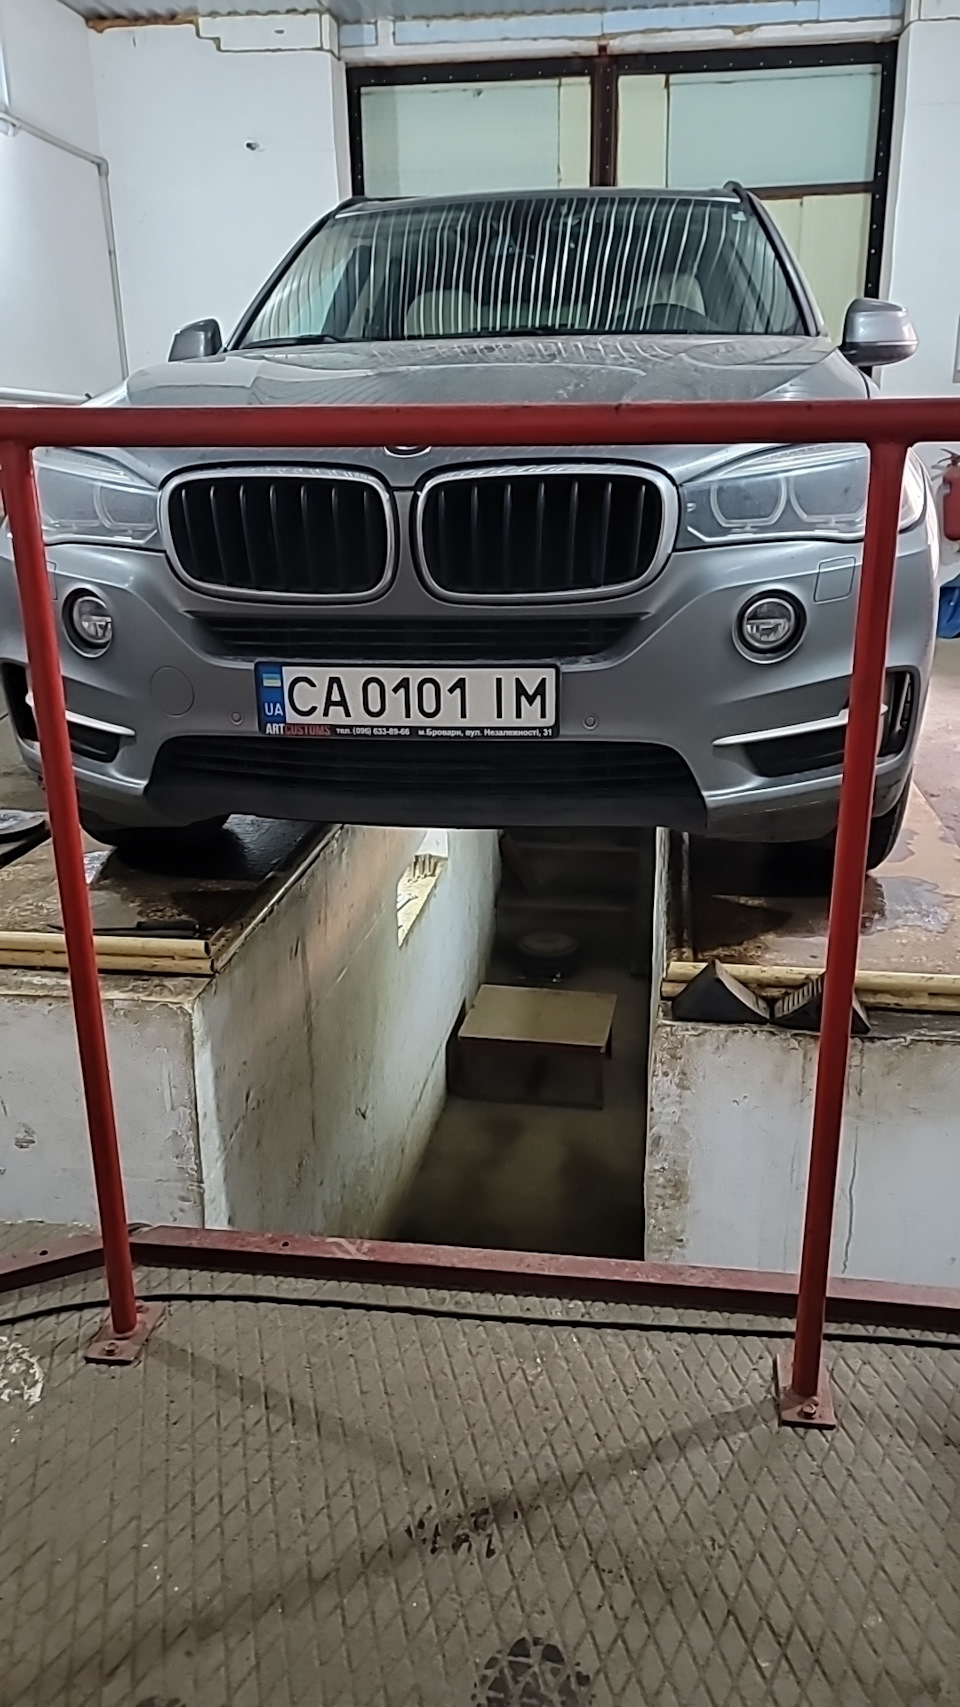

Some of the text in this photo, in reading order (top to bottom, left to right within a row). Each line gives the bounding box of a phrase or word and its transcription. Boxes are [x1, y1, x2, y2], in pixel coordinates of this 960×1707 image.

[288, 676, 547, 719] CA 0101 IM
[264, 702, 284, 716] UA
[265, 723, 331, 736] ARTCUSTOMS
[543, 728, 552, 736] 31
